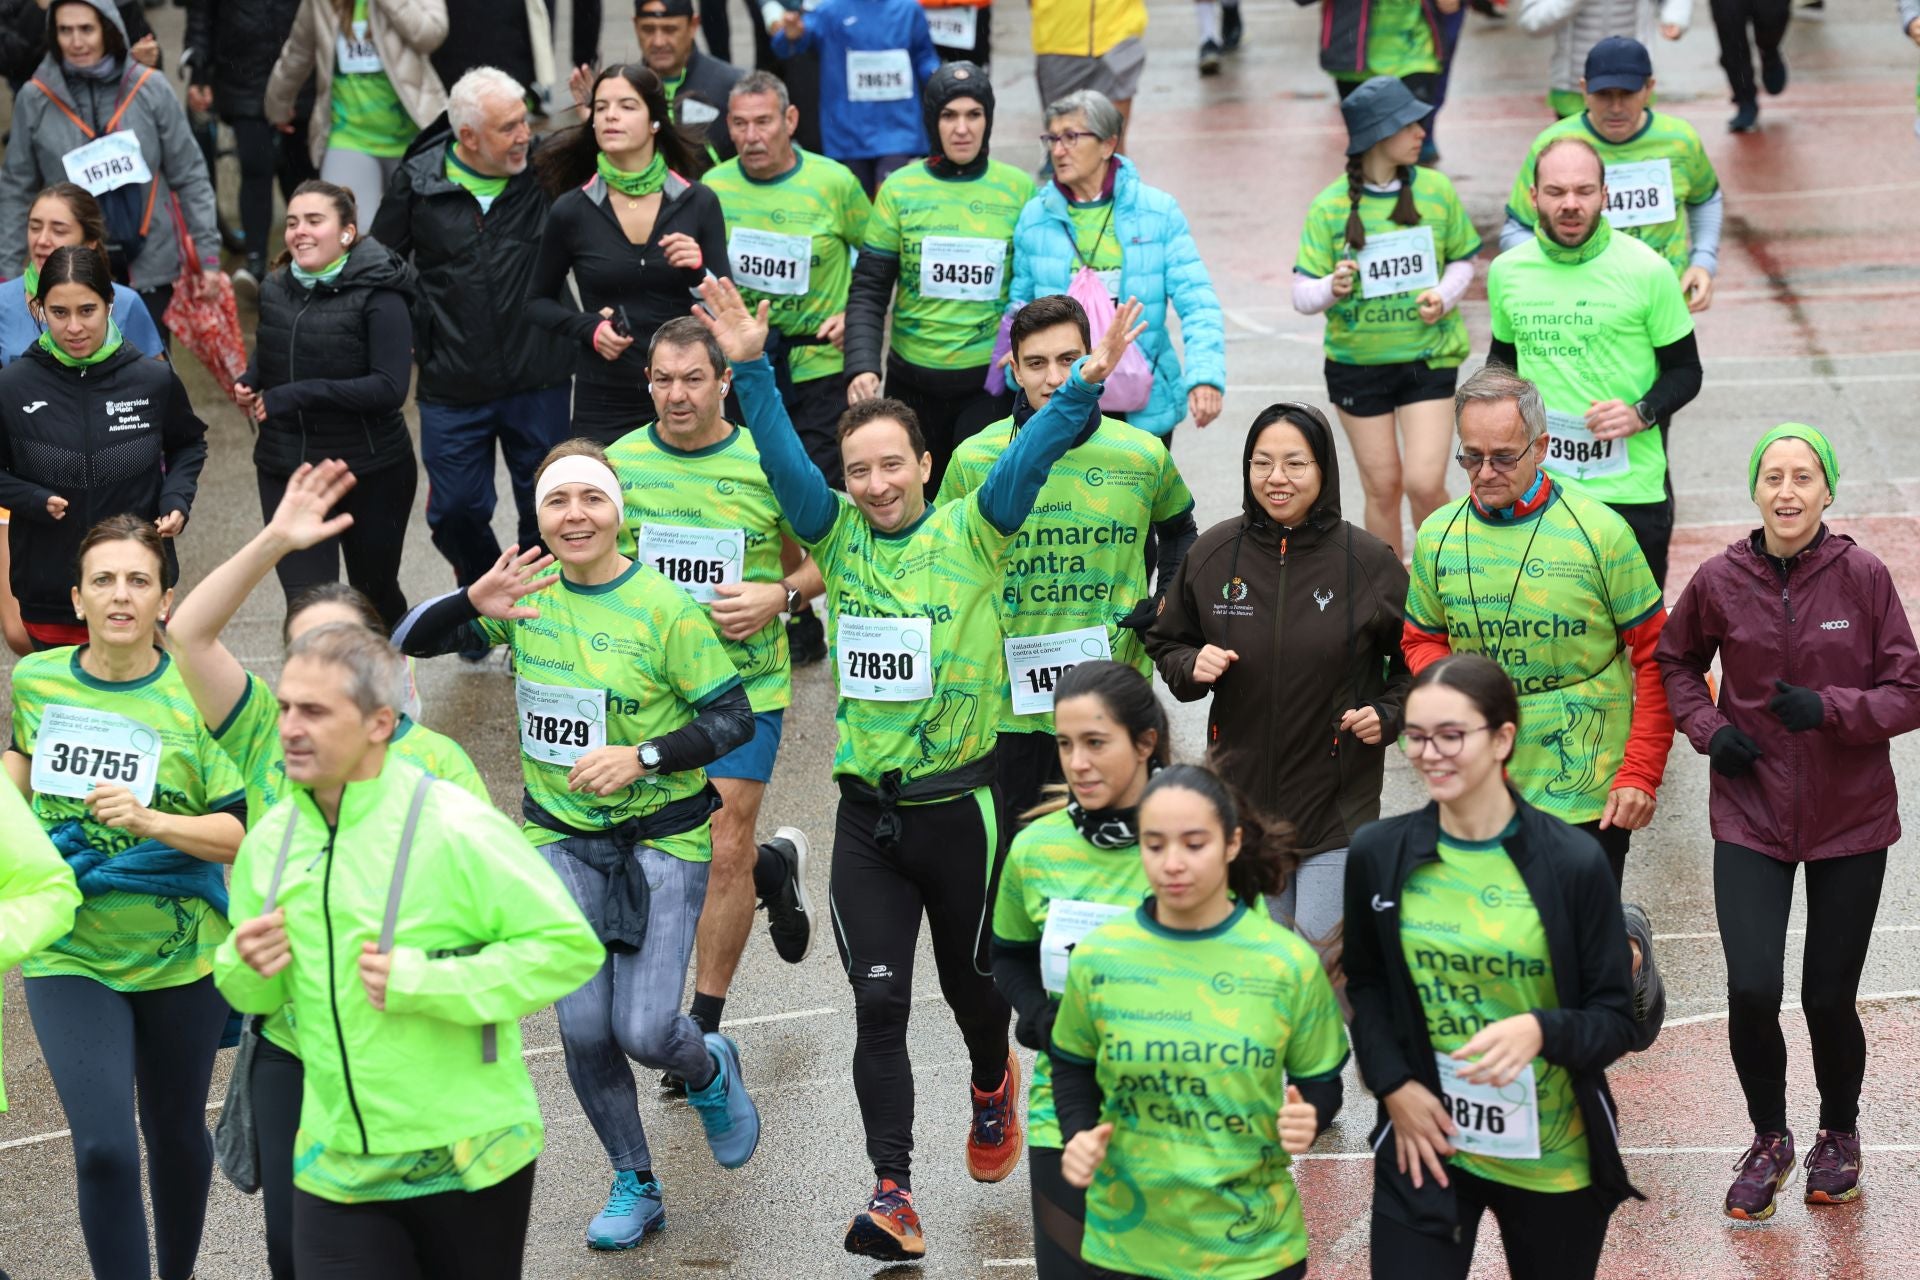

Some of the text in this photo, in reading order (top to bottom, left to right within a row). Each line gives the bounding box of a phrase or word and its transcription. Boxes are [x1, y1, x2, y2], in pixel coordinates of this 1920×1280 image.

[83, 155, 133, 184] 16783
[740, 254, 797, 279] 35041
[932, 263, 995, 285] 34356
[1369, 254, 1423, 280] 44739
[1364, 303, 1418, 323] cánc
[1513, 311, 1594, 326] En marcha
[118, 415, 141, 424] Sprint
[1551, 437, 1613, 463] 39847
[645, 508, 702, 518] Valladolid
[1030, 501, 1072, 515] ladolid
[1015, 519, 1138, 549] n marcha
[655, 557, 725, 584] 11805
[1006, 551, 1086, 578] contra
[1002, 580, 1024, 605] el
[1455, 592, 1512, 606] Valladolid
[1447, 614, 1588, 639] En marcha
[1011, 641, 1042, 651] Valladolid
[848, 650, 914, 681] 27830
[1026, 664, 1076, 693] 147
[1512, 674, 1565, 696] ncer
[49, 719, 74, 729] contra
[51, 711, 90, 724] Valladolid
[527, 711, 590, 747] 27829
[51, 742, 140, 783] 36755
[1415, 949, 1546, 979] marcha
[1415, 976, 1483, 1006] ntra
[1144, 1037, 1277, 1069] marcha
